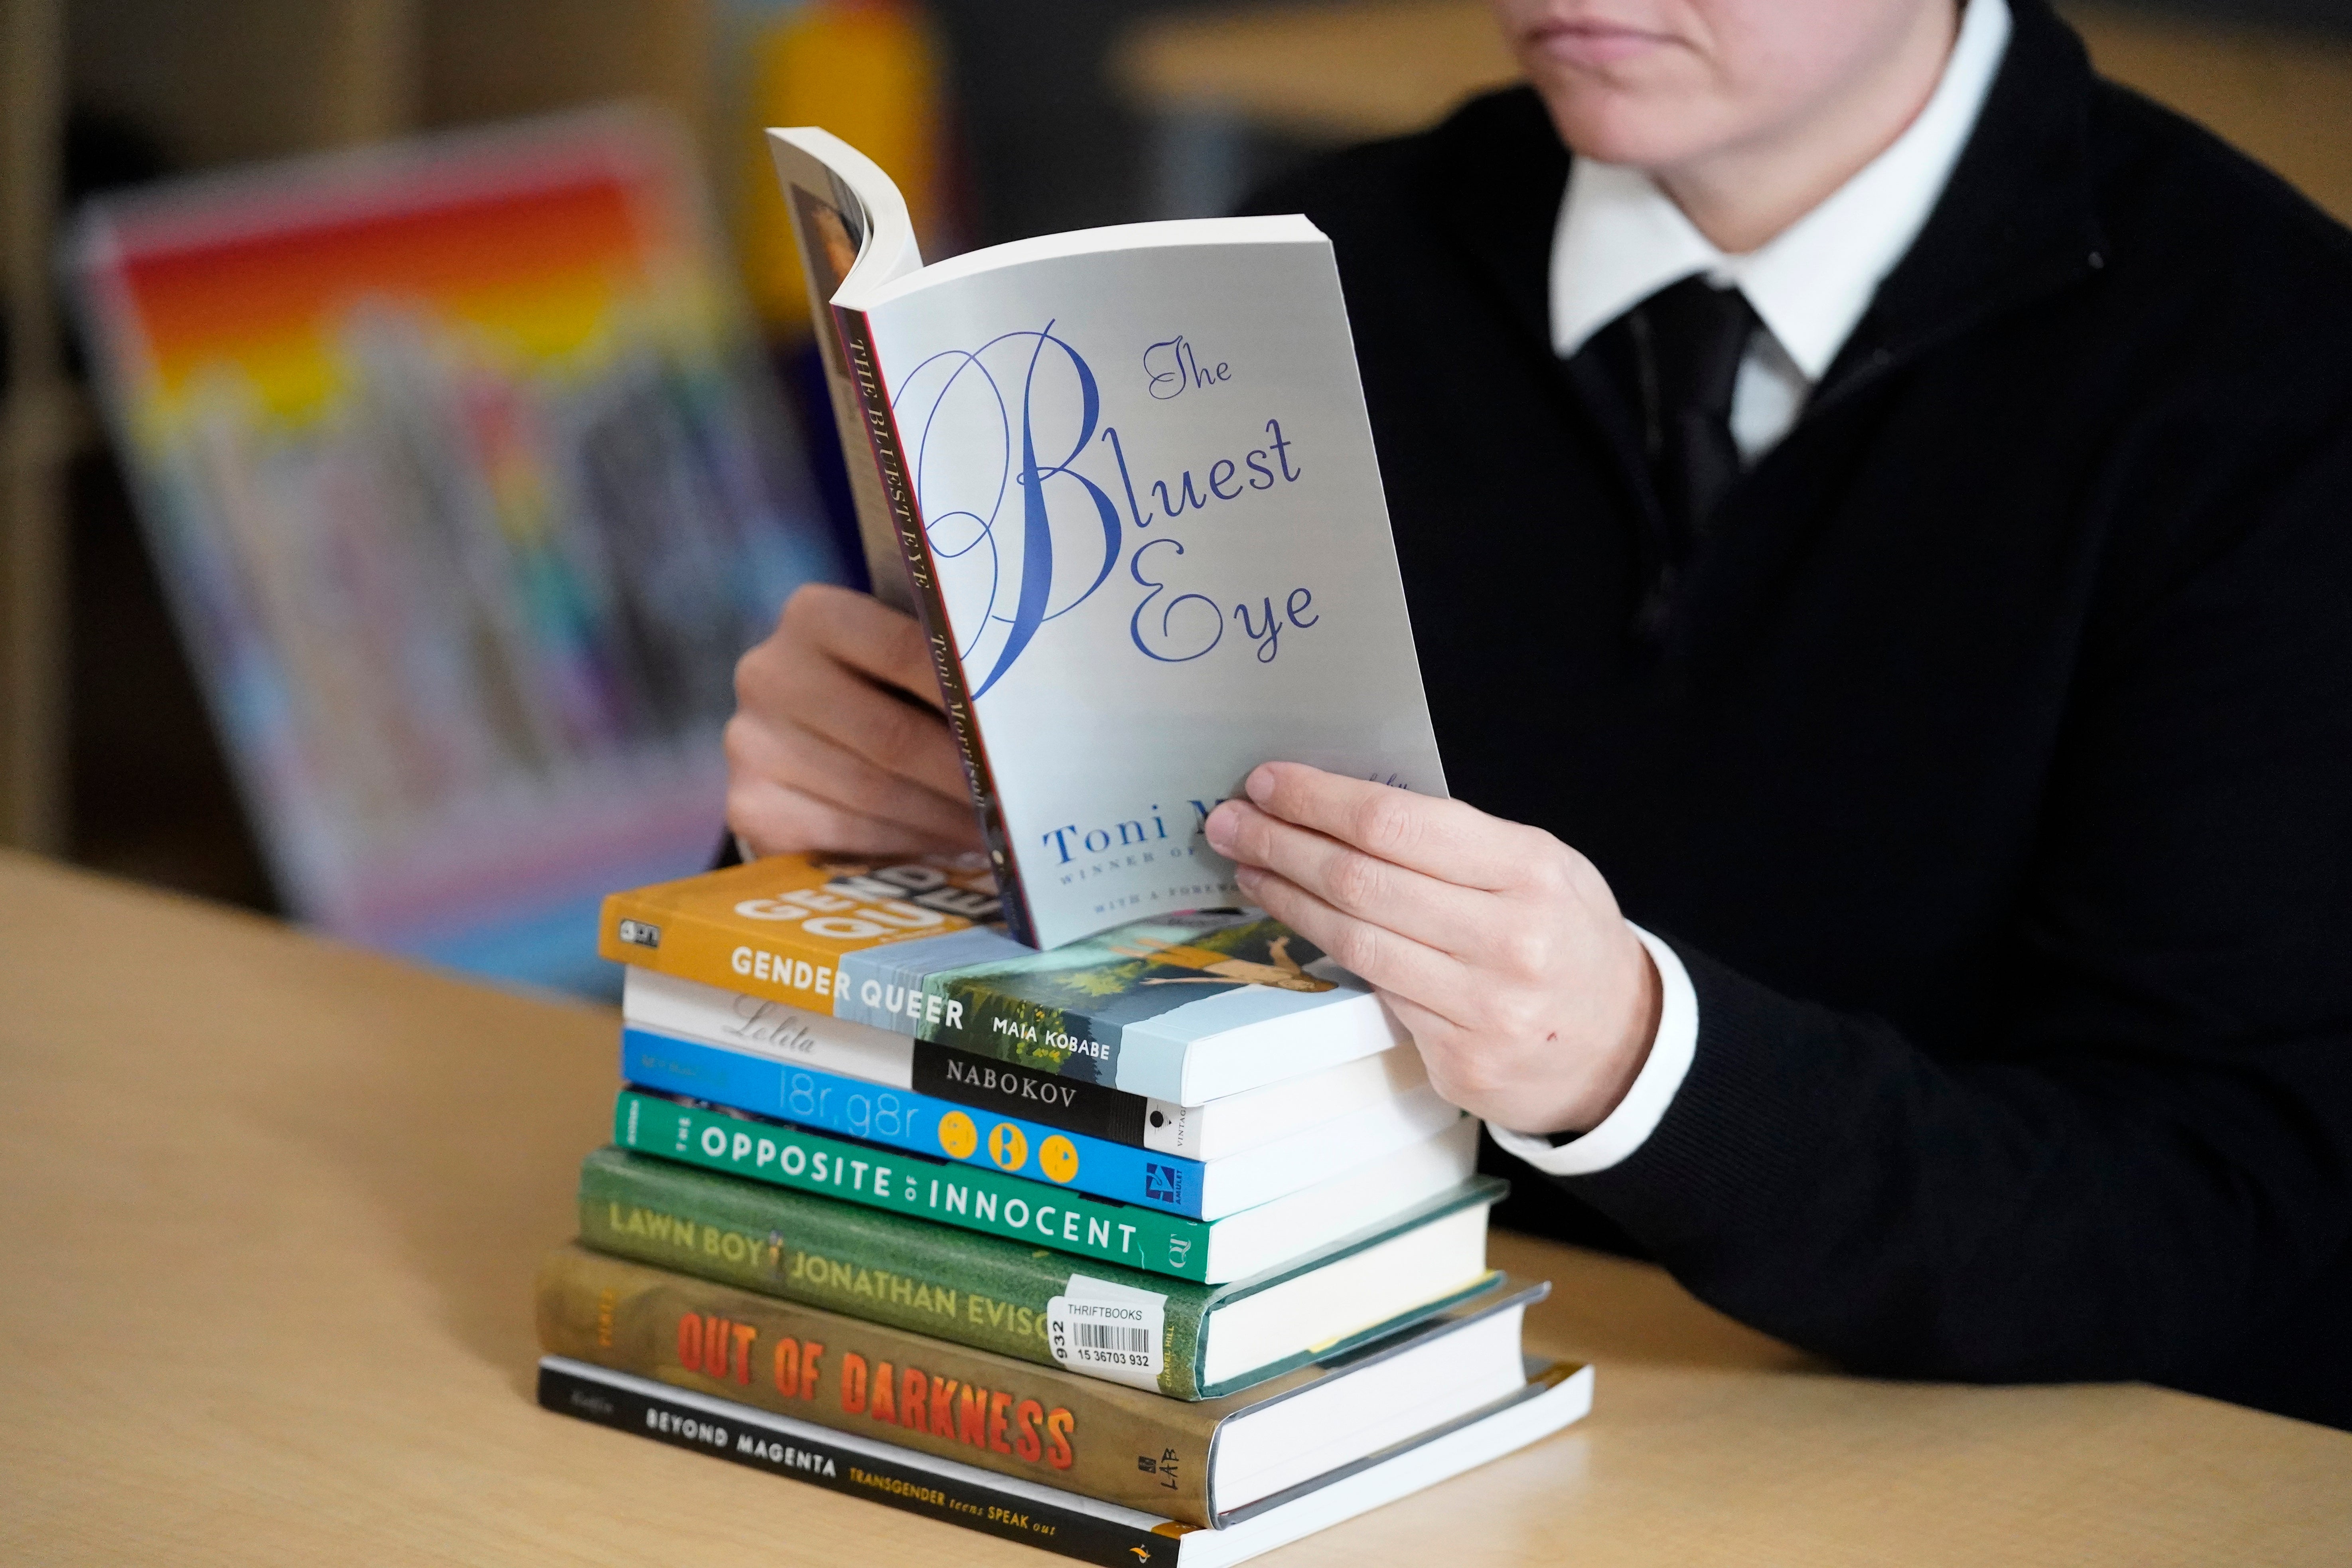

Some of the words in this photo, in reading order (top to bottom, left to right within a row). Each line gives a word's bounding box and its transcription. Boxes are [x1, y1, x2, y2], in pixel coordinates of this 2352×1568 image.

[1144, 335, 1231, 399] The
[849, 339, 878, 398] THE
[867, 408, 912, 523] BLUEST
[902, 530, 930, 589] EYE
[892, 319, 1301, 701] Bluest
[1131, 538, 1319, 663] Eye
[931, 634, 957, 689] Toni
[948, 698, 986, 808] Morrison
[1042, 803, 1168, 865] Toni
[732, 946, 850, 1000] GENDER
[860, 980, 963, 1030] QUEER
[992, 1017, 1038, 1043] MAIA
[1045, 1030, 1111, 1061] KOBABE
[947, 1059, 1077, 1108] NABOKOV
[1177, 1106, 1186, 1147] VINTAG
[700, 1126, 892, 1197] OPPOSITE
[904, 1175, 918, 1201] OF
[929, 1179, 1137, 1253] INNOCENT
[609, 1201, 696, 1249] LAWN
[703, 1225, 764, 1266] BOY
[790, 1251, 956, 1317] JONATHAN
[968, 1294, 1049, 1341] EVISO
[1067, 1304, 1143, 1321] THRIFTBOOKS
[1052, 1320, 1068, 1359] 932
[1078, 1349, 1091, 1360] 15
[1094, 1351, 1126, 1364] 36703
[1129, 1354, 1149, 1367] 932
[1165, 1325, 1174, 1347] HILL
[678, 1312, 757, 1386] OUT
[774, 1337, 825, 1402] OF
[841, 1351, 1076, 1471] DARKNESS
[645, 1408, 728, 1448] BEYOND
[736, 1433, 837, 1479] MAGENTA
[849, 1467, 945, 1506] TRANSGENDER
[987, 1505, 1030, 1529] SPEAK
[1032, 1522, 1056, 1536] out
[1159, 1448, 1179, 1490] LAB
